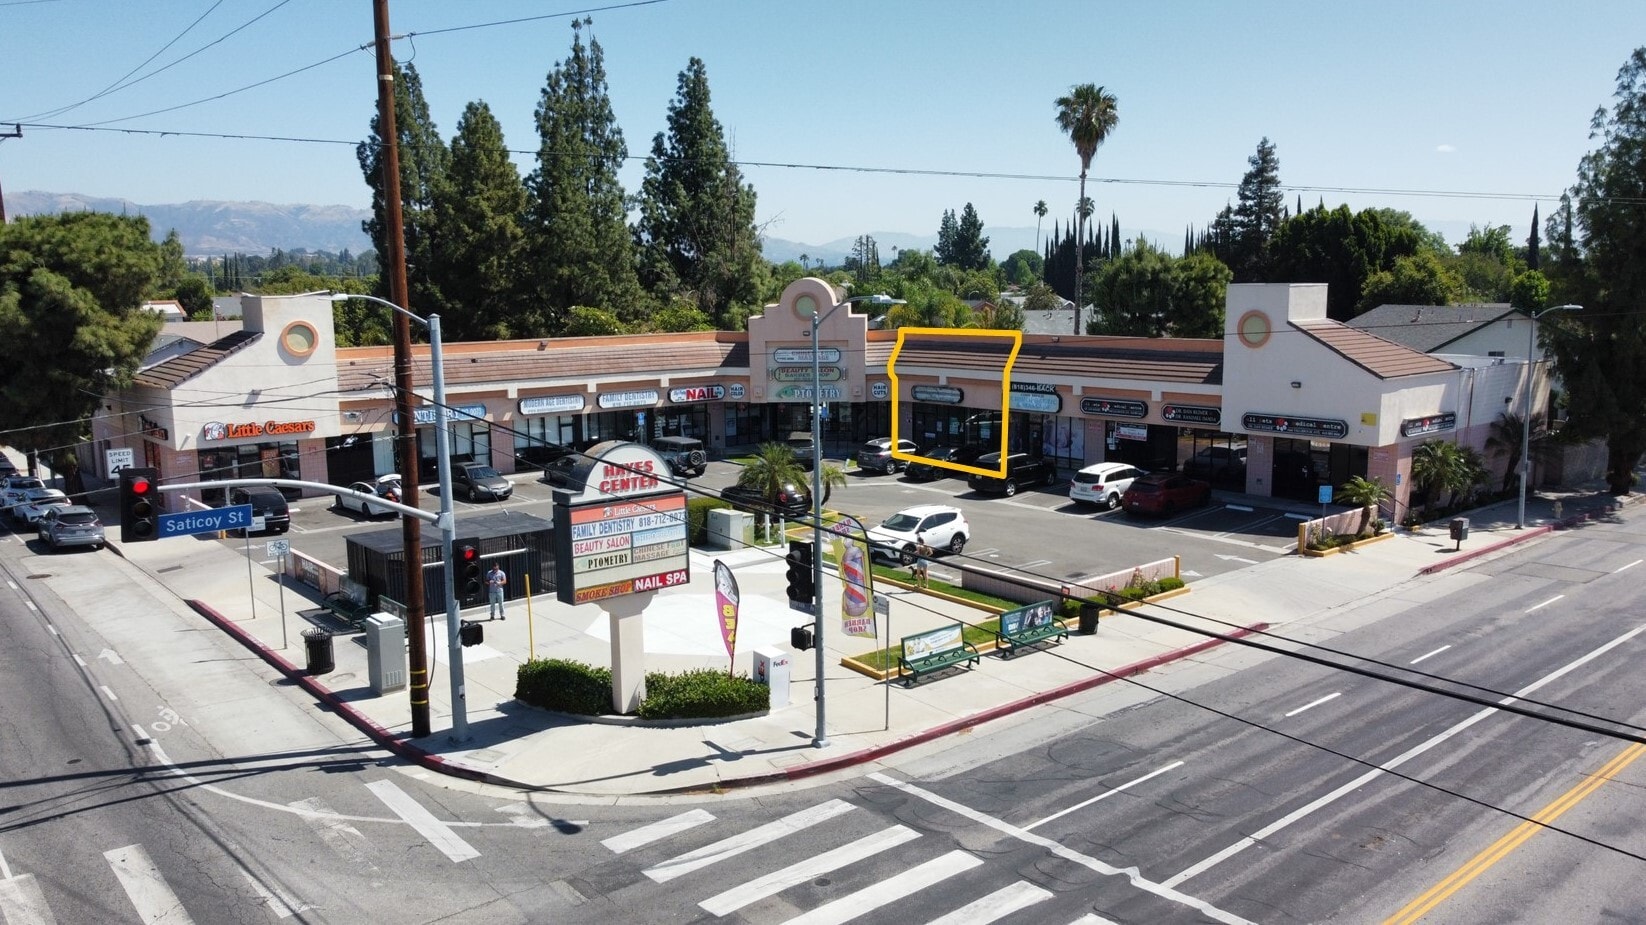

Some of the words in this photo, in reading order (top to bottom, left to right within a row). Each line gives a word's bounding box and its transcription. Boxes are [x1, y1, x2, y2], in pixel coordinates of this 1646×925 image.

[556, 395, 580, 406] DENTISTRY
[602, 393, 623, 403] FAMILY
[624, 390, 655, 401] DENTISTRY
[686, 387, 718, 400] NAIL
[794, 389, 840, 398] PTOETRY
[226, 422, 263, 438] Little
[264, 420, 315, 435] Caesars
[604, 460, 653, 478] HAYES
[599, 474, 658, 494] CENTER
[614, 506, 631, 516] Little
[166, 516, 222, 532] Saticoy
[228, 511, 244, 524] St
[572, 524, 597, 540] FAMILY
[600, 519, 635, 535] DENTISTRY
[574, 540, 603, 555] BEAUTY
[606, 536, 630, 547] SALON
[634, 551, 669, 561] MASSAGE
[635, 578, 663, 591] NAIL
[666, 571, 687, 585] SPA
[576, 587, 608, 602] SMOKE
[608, 581, 632, 595] SHOP
[773, 659, 788, 668] FedEx
